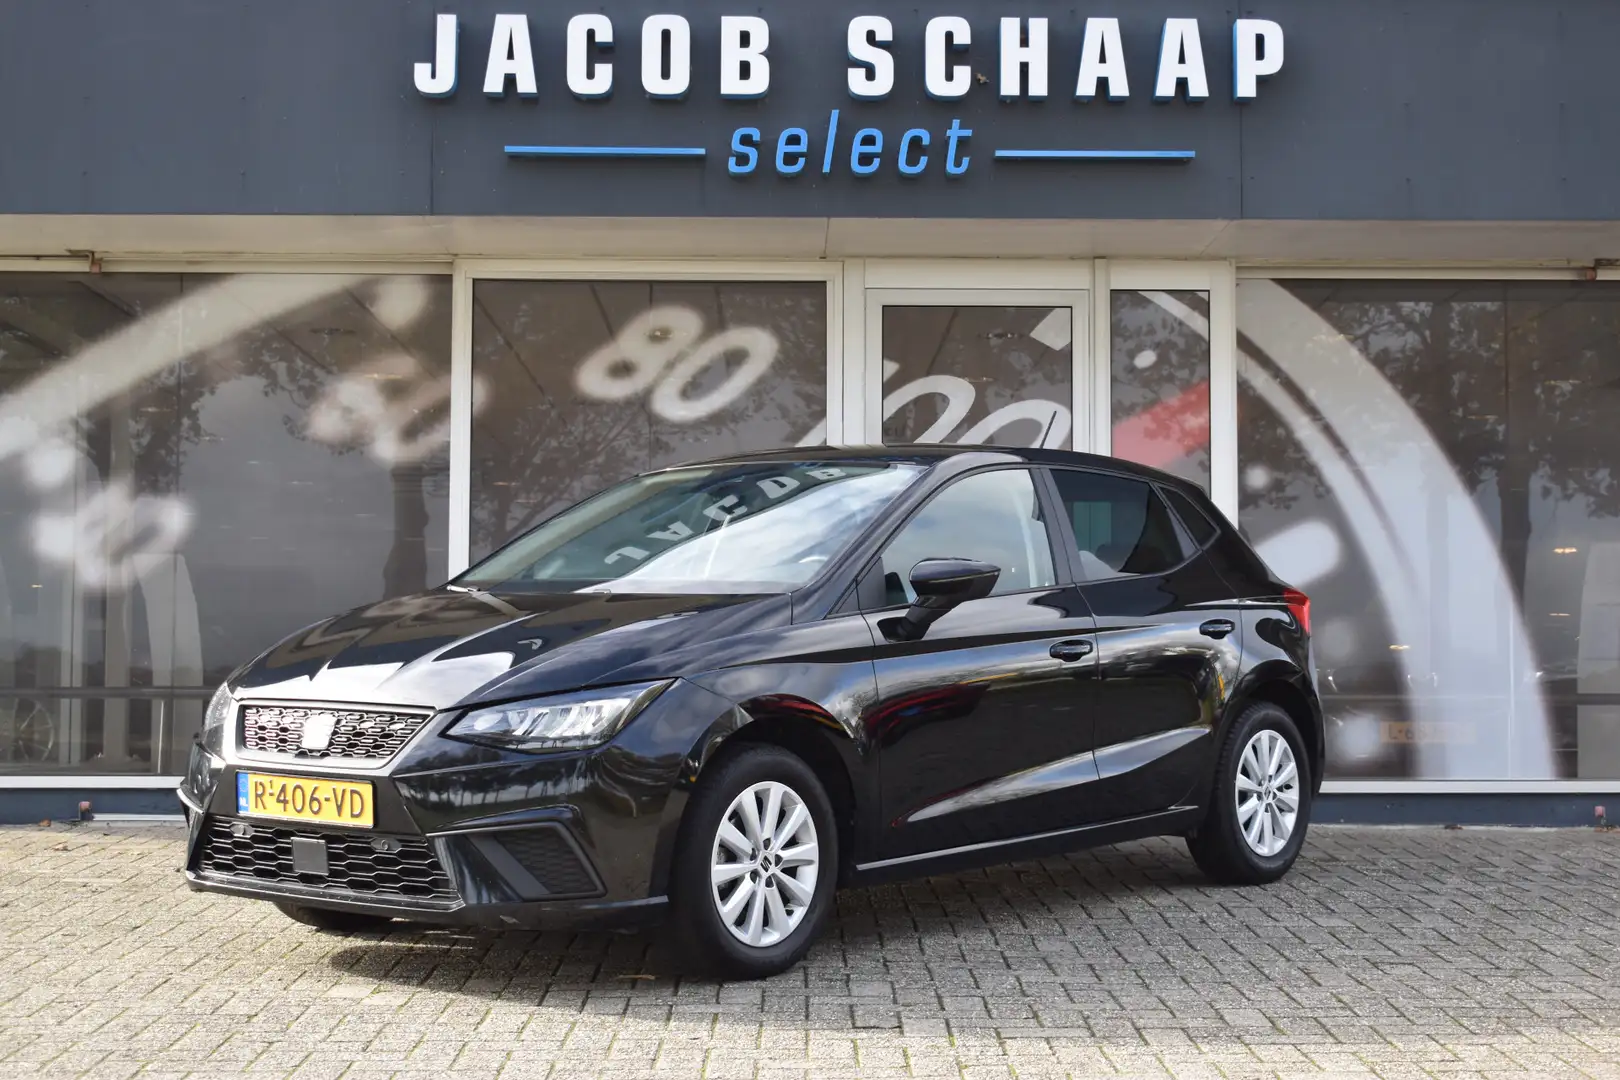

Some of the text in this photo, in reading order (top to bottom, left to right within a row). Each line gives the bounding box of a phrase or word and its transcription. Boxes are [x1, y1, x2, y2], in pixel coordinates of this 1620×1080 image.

[413, 13, 1284, 101] JACOB SCHAAP
[727, 108, 974, 177] select
[575, 305, 779, 421] 80
